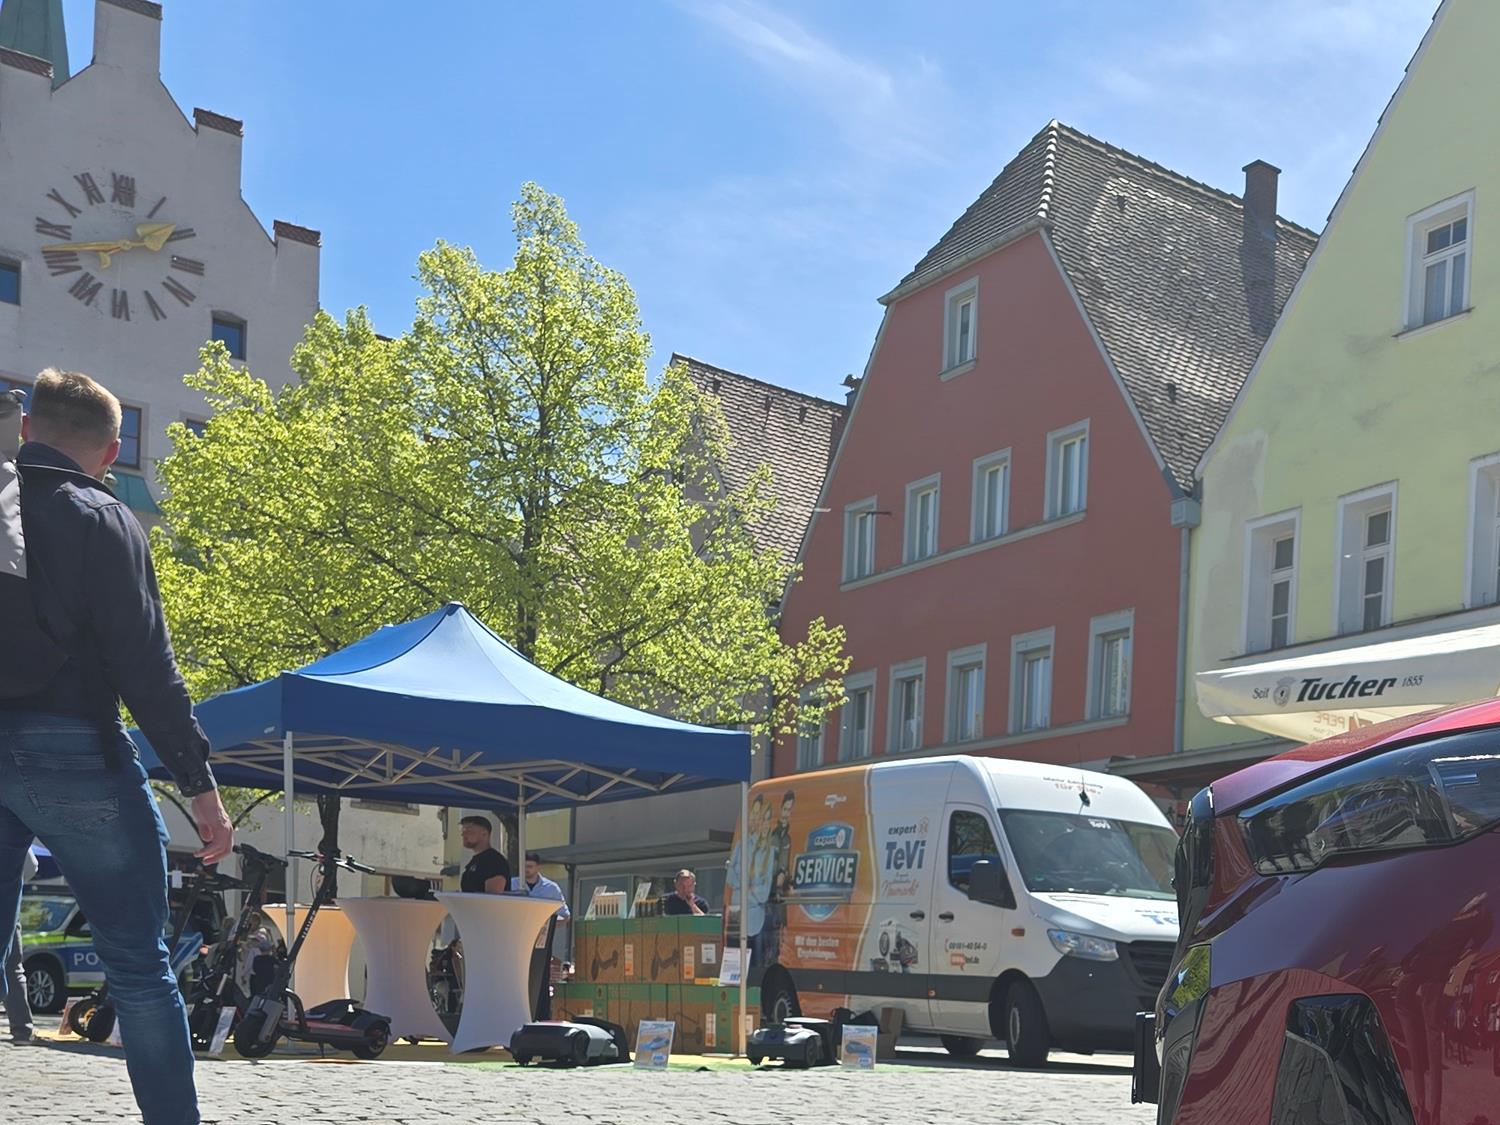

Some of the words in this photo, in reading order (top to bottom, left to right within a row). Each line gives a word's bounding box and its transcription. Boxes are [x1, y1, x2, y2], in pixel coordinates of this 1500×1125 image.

[1252, 688, 1270, 699] Seit
[1296, 675, 1398, 702] Tucher
[1402, 675, 1424, 687] 1855
[888, 824, 917, 836] expert
[885, 840, 927, 870] TeVi
[796, 857, 855, 885] SERVICE
